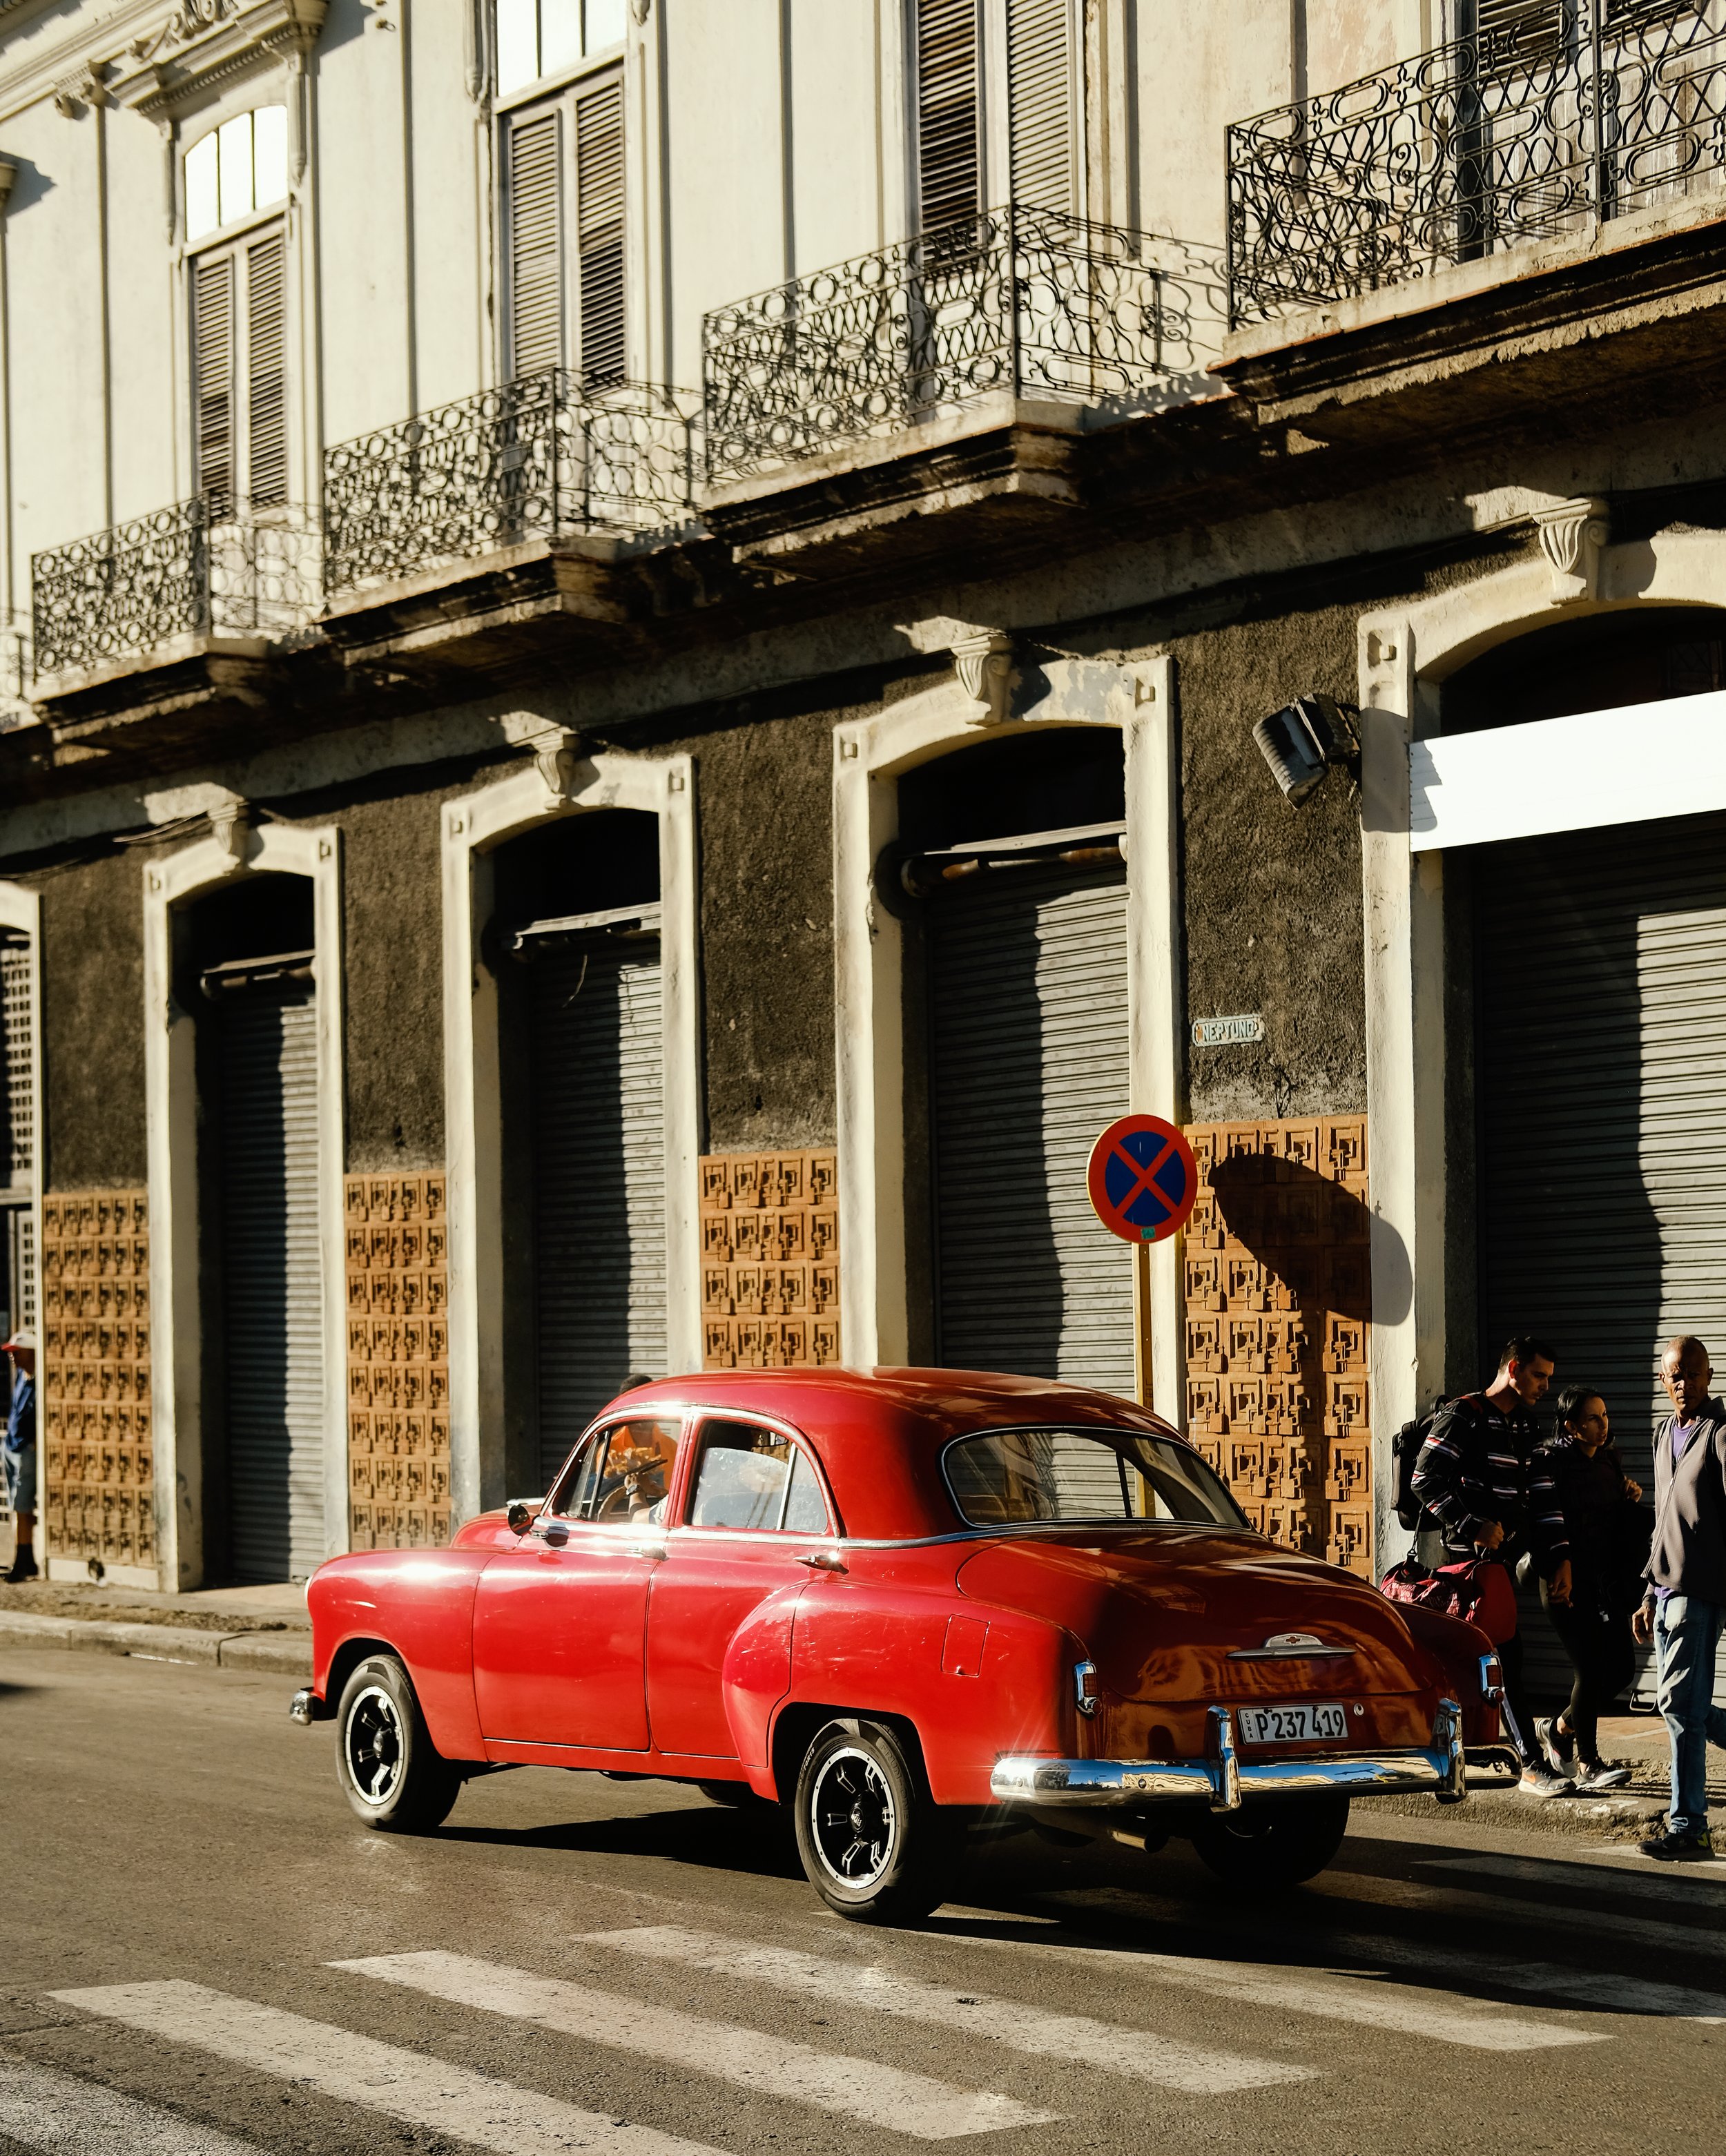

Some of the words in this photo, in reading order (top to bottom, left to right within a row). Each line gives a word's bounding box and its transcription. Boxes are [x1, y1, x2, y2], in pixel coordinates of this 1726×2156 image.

[1203, 1020, 1255, 1042] NEPTUNO
[1245, 1713, 1254, 1738] CUBA
[1312, 1709, 1344, 1737] 419
